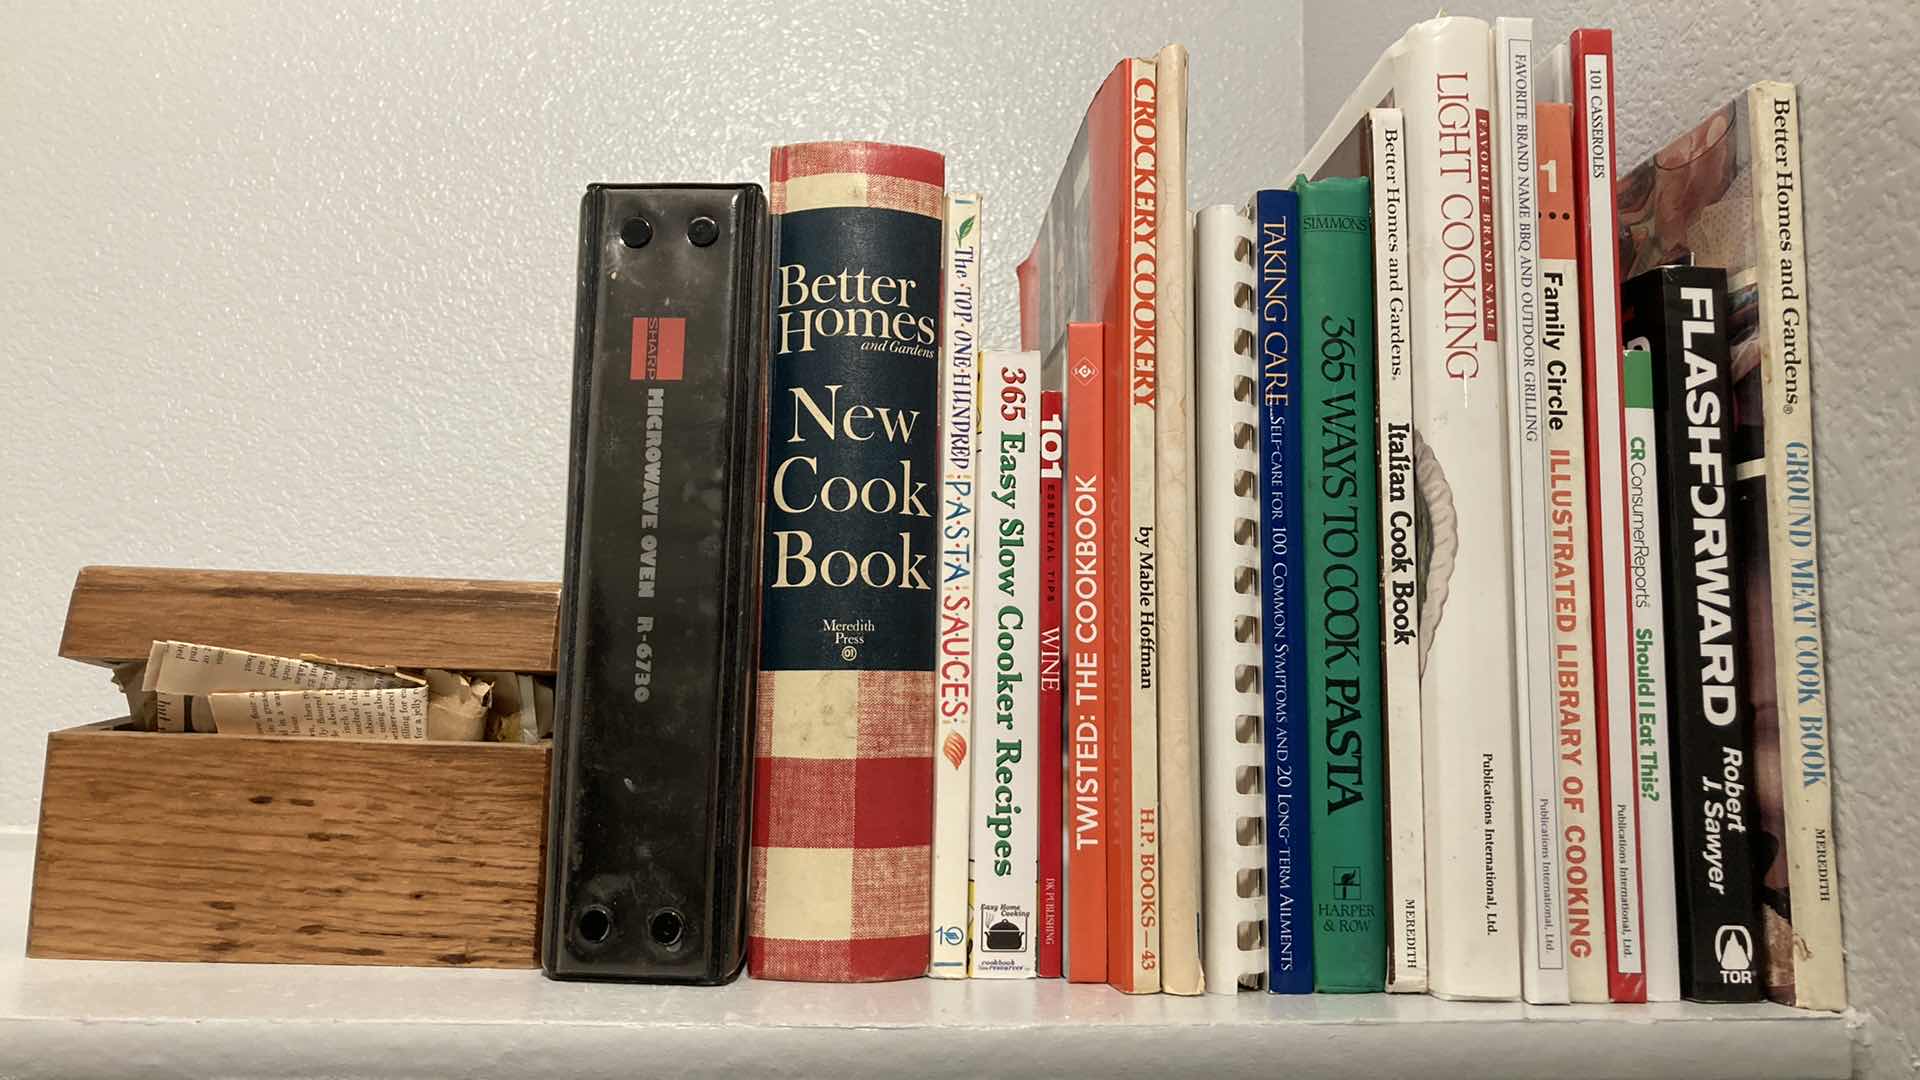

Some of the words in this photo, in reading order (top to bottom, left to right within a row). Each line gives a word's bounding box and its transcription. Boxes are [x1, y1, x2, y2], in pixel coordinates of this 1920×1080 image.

[1515, 54, 1527, 118] FAVORITE
[1589, 69, 1601, 91] 101
[1385, 129, 1398, 184] Better
[1437, 71, 1472, 184] LIGHT
[1516, 123, 1529, 172] BRAND
[1590, 95, 1605, 179] CASSEROLES
[1774, 98, 1790, 167] Better
[1134, 77, 1157, 249] CROCKERY
[1479, 118, 1490, 203] FAVORITE
[1540, 159, 1557, 193] 1
[1303, 218, 1368, 232] SIMMONS
[1386, 188, 1400, 253] Homes
[1518, 177, 1531, 218] NAME
[1776, 170, 1793, 251] Homes
[954, 246, 974, 279] The
[1263, 215, 1288, 323] TAKING
[1481, 213, 1493, 273] BRAND
[1519, 223, 1532, 251] BBQ
[778, 264, 916, 308] Better
[1389, 257, 1404, 292] and
[1441, 193, 1479, 380] COOKING
[1520, 256, 1533, 288] AND
[1780, 258, 1799, 301] and
[777, 307, 935, 355] Homes
[953, 287, 972, 323] TOP
[1133, 252, 1157, 410] COOKERY
[1484, 283, 1496, 333] NAME
[1521, 292, 1536, 367] OUTDOOR
[1543, 272, 1565, 351] Family
[647, 317, 659, 381] SHARP
[860, 340, 888, 352] and
[889, 340, 935, 359] Gardens
[953, 330, 972, 368] ONE
[1264, 331, 1289, 407] CARE
[1321, 315, 1356, 383] 365
[787, 384, 921, 444] New
[1001, 366, 1027, 421] 365
[1523, 372, 1538, 442] GRILLING
[1547, 359, 1568, 431] Circle
[641, 388, 665, 529] MICROWAVE
[991, 431, 1026, 510] Easy
[1041, 413, 1062, 478] 101
[1270, 416, 1285, 487] SELF-CARE
[1322, 389, 1358, 499] WAYS
[1388, 422, 1410, 502] Italian
[773, 456, 932, 517] Cook
[1272, 491, 1284, 520] FOR
[1680, 287, 1737, 727] FLASHFORWARD
[1784, 441, 1812, 547] GROUND
[1047, 484, 1056, 561] ESSENTIAL
[1134, 526, 1153, 548] by
[1272, 527, 1288, 555] 100
[1322, 505, 1359, 558] TO
[1389, 510, 1414, 573] Cook
[1549, 449, 1577, 633] ILLUSTRATED
[638, 534, 658, 598] OVEN
[771, 530, 931, 590] Book
[998, 517, 1025, 597] Slow
[1047, 571, 1056, 602] TIPS
[1075, 474, 1098, 644] COOKBOOK
[1139, 552, 1155, 606] Mable
[823, 619, 875, 632] Meredith
[1272, 562, 1288, 638] COMMON
[1323, 563, 1361, 669] COOK
[1391, 580, 1416, 645] Book
[1791, 558, 1817, 628] MEAT
[634, 616, 654, 703] R-6730
[835, 632, 865, 645] Press
[996, 605, 1024, 730] Cooker
[1041, 627, 1060, 692] WINE
[1140, 611, 1156, 689] Hoffman
[1636, 628, 1656, 697] Should
[1794, 635, 1822, 705] COOK
[1075, 652, 1098, 706] THE
[1273, 643, 1289, 723] SYMPTOMS
[1556, 644, 1582, 765] LIBRARY
[1275, 727, 1289, 762] AND
[1325, 675, 1364, 817] PASTA
[1638, 713, 1657, 746] Eat
[1799, 716, 1827, 788] BOOK
[986, 738, 1023, 877] Recipes
[1076, 714, 1098, 851] TWISTED:
[1277, 765, 1293, 788] 20
[1482, 753, 1493, 826] Publications
[1562, 775, 1584, 813] OF
[1641, 751, 1660, 801] This?
[1702, 775, 1722, 792] J.
[1722, 746, 1746, 833] Robert
[1140, 808, 1154, 848] H.P.
[1277, 794, 1293, 889] LONG-TERM
[1539, 798, 1549, 859] Publications
[1617, 803, 1627, 864] Publications
[1703, 800, 1725, 895] Sawyer
[1484, 828, 1497, 910] International,
[1564, 825, 1592, 959] COOKING
[1815, 828, 1831, 902] MEREDITH
[1045, 892, 1056, 945] PUBLISHING
[1279, 893, 1294, 972] AILMENTS
[1318, 903, 1375, 918] HARPER
[1323, 919, 1335, 932] &
[1339, 919, 1371, 933] ROW
[1405, 899, 1417, 969] MEREDITH
[1486, 913, 1498, 936] Ltd.
[1720, 970, 1752, 984] TOR
